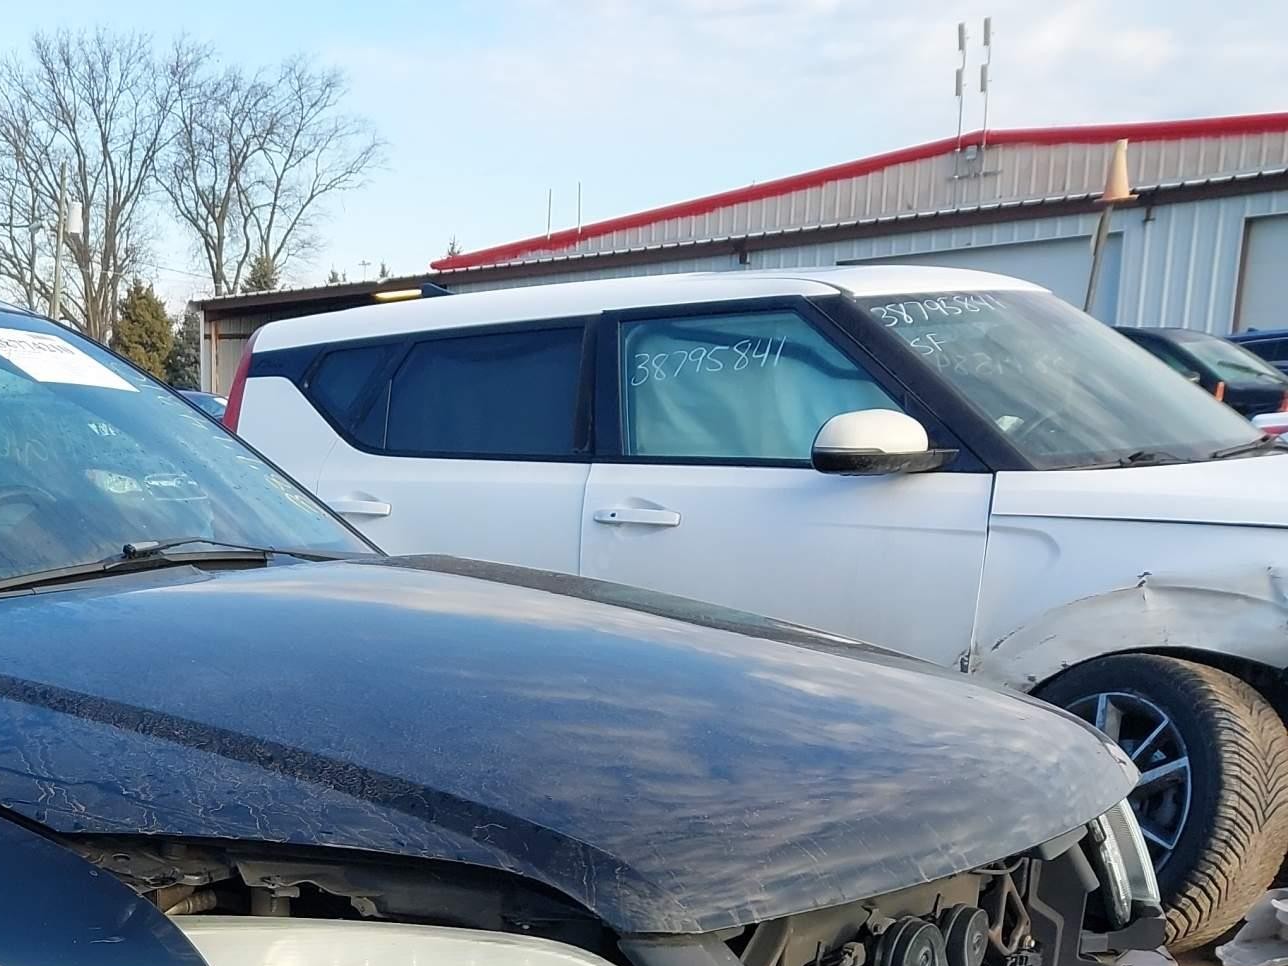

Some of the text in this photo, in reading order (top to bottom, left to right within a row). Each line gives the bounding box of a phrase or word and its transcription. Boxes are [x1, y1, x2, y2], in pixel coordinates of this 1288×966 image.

[870, 294, 1007, 328] 38795841
[631, 335, 787, 386] 38795841
[910, 333, 946, 356] SF
